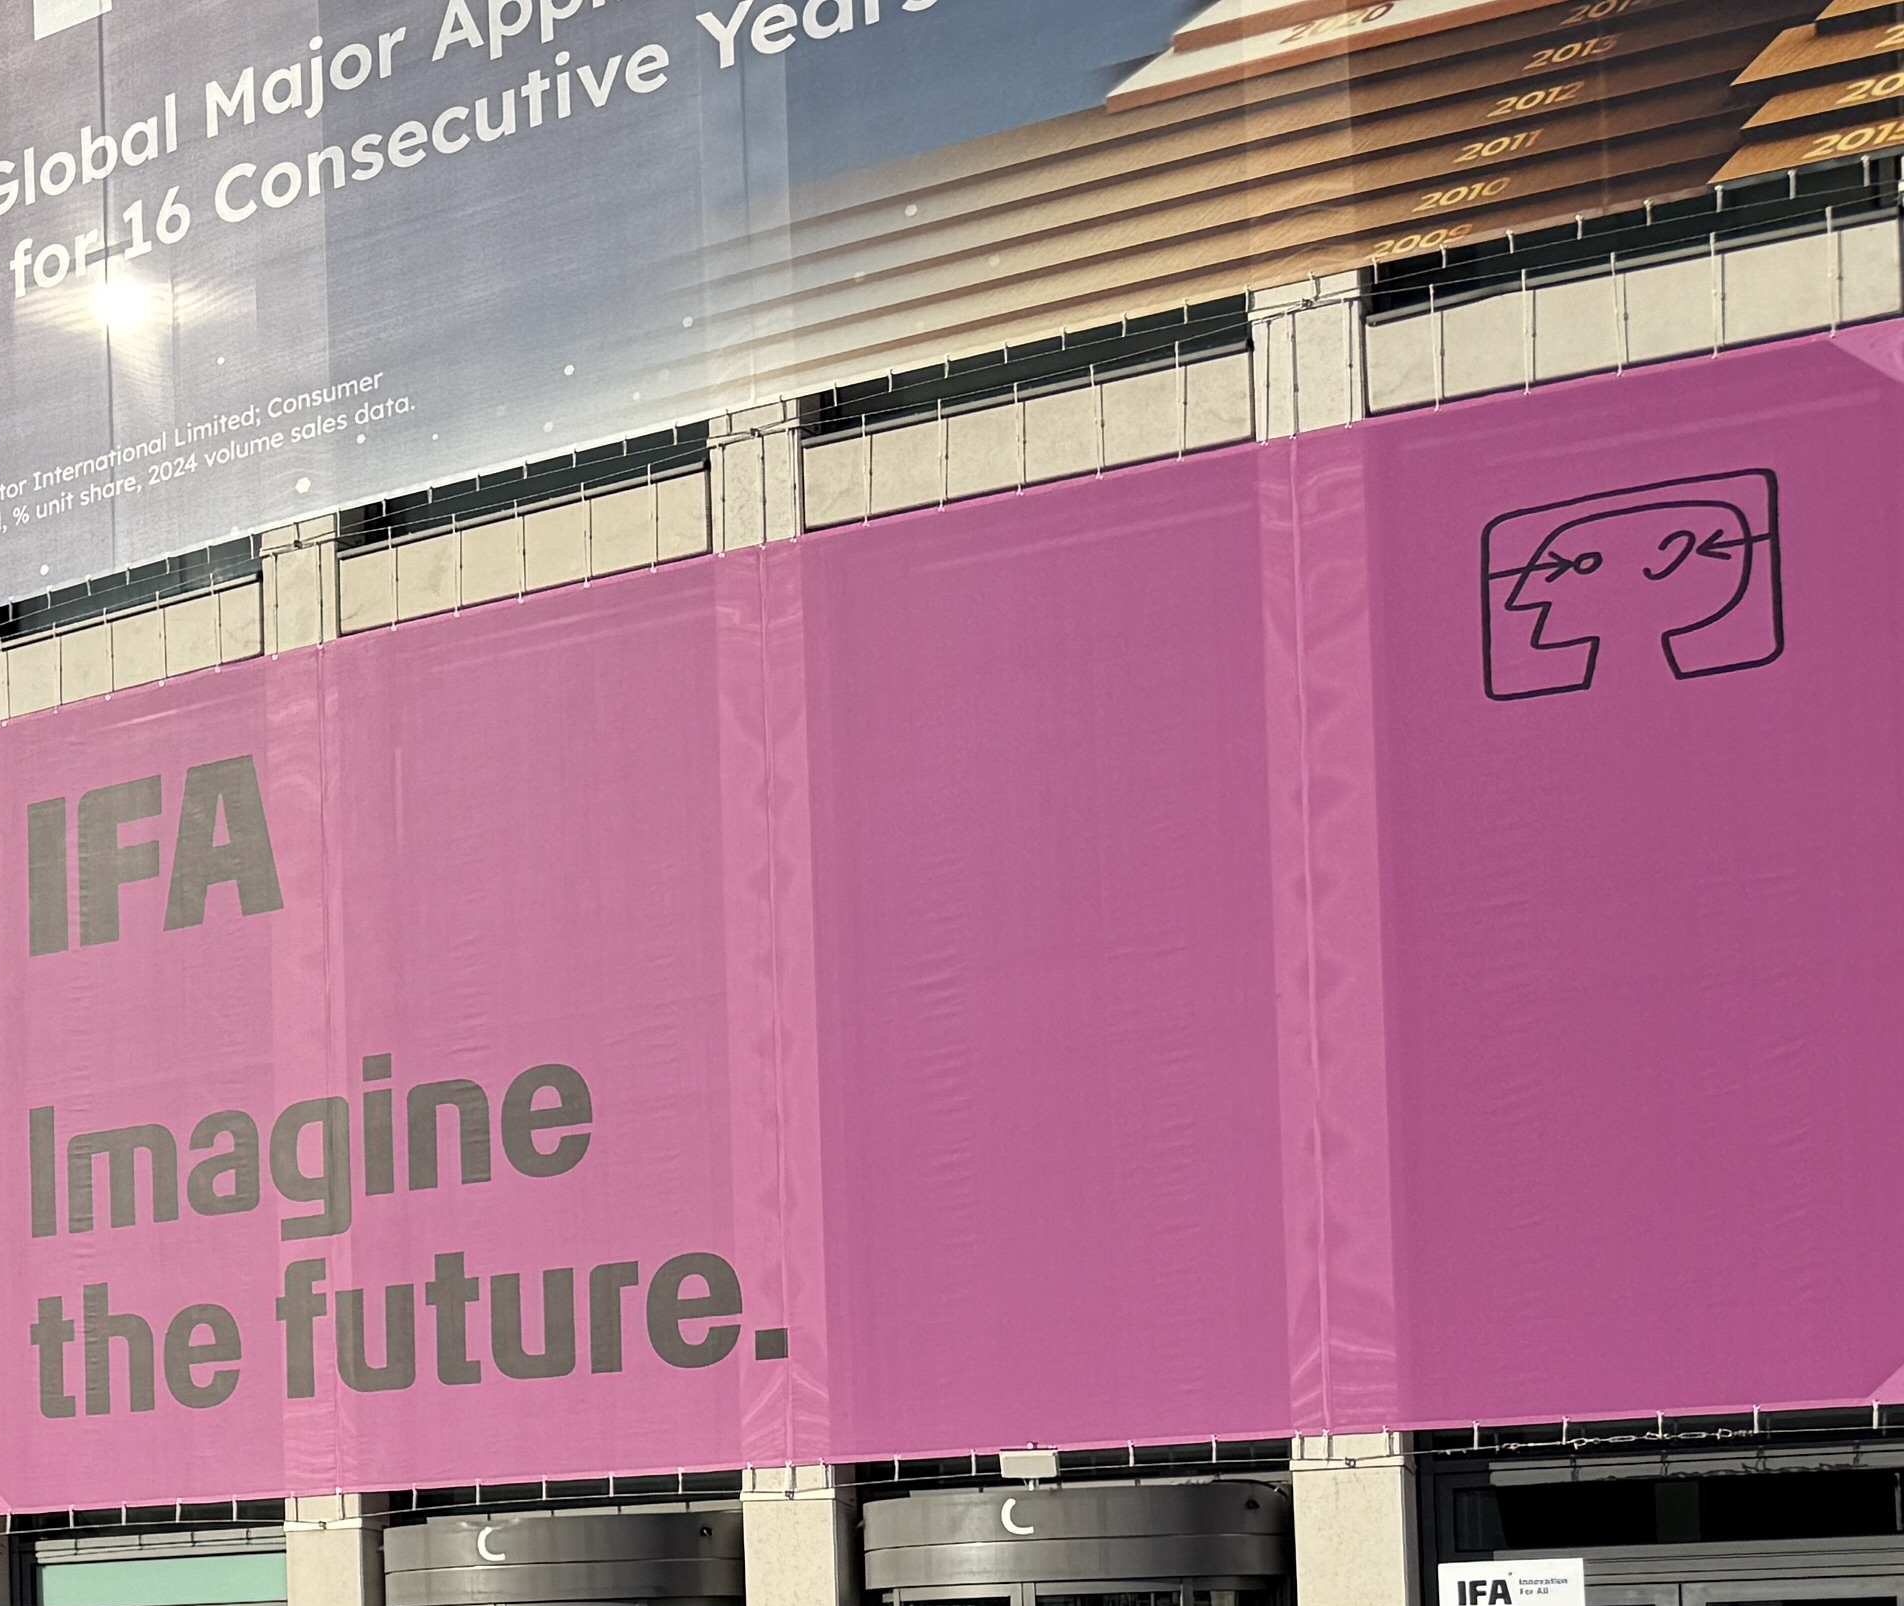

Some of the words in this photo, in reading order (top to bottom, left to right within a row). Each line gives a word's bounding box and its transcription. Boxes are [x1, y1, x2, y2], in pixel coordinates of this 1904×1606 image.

[205, 27, 407, 139] Major
[1486, 80, 1586, 118] 2012
[1522, 33, 1623, 70] 2013
[9, 228, 99, 299] for
[121, 186, 191, 260] 16
[214, 44, 670, 223] Consecutive
[1411, 177, 1511, 213] 2010
[1452, 128, 1544, 164] 2011
[12, 506, 30, 527] %
[35, 490, 74, 520] unit
[79, 474, 142, 506] share,
[148, 453, 198, 486] 2024
[204, 431, 284, 468] volume
[290, 413, 348, 443] sales
[354, 395, 416, 425] data.
[33, 431, 167, 491] International
[174, 404, 261, 448] Limited;
[267, 371, 384, 419] Consumer
[27, 753, 284, 957] IFA
[28, 1053, 593, 1241] Imagine
[29, 1281, 242, 1419] the
[275, 1251, 789, 1399] future.
[1457, 1579, 1512, 1606] IFA
